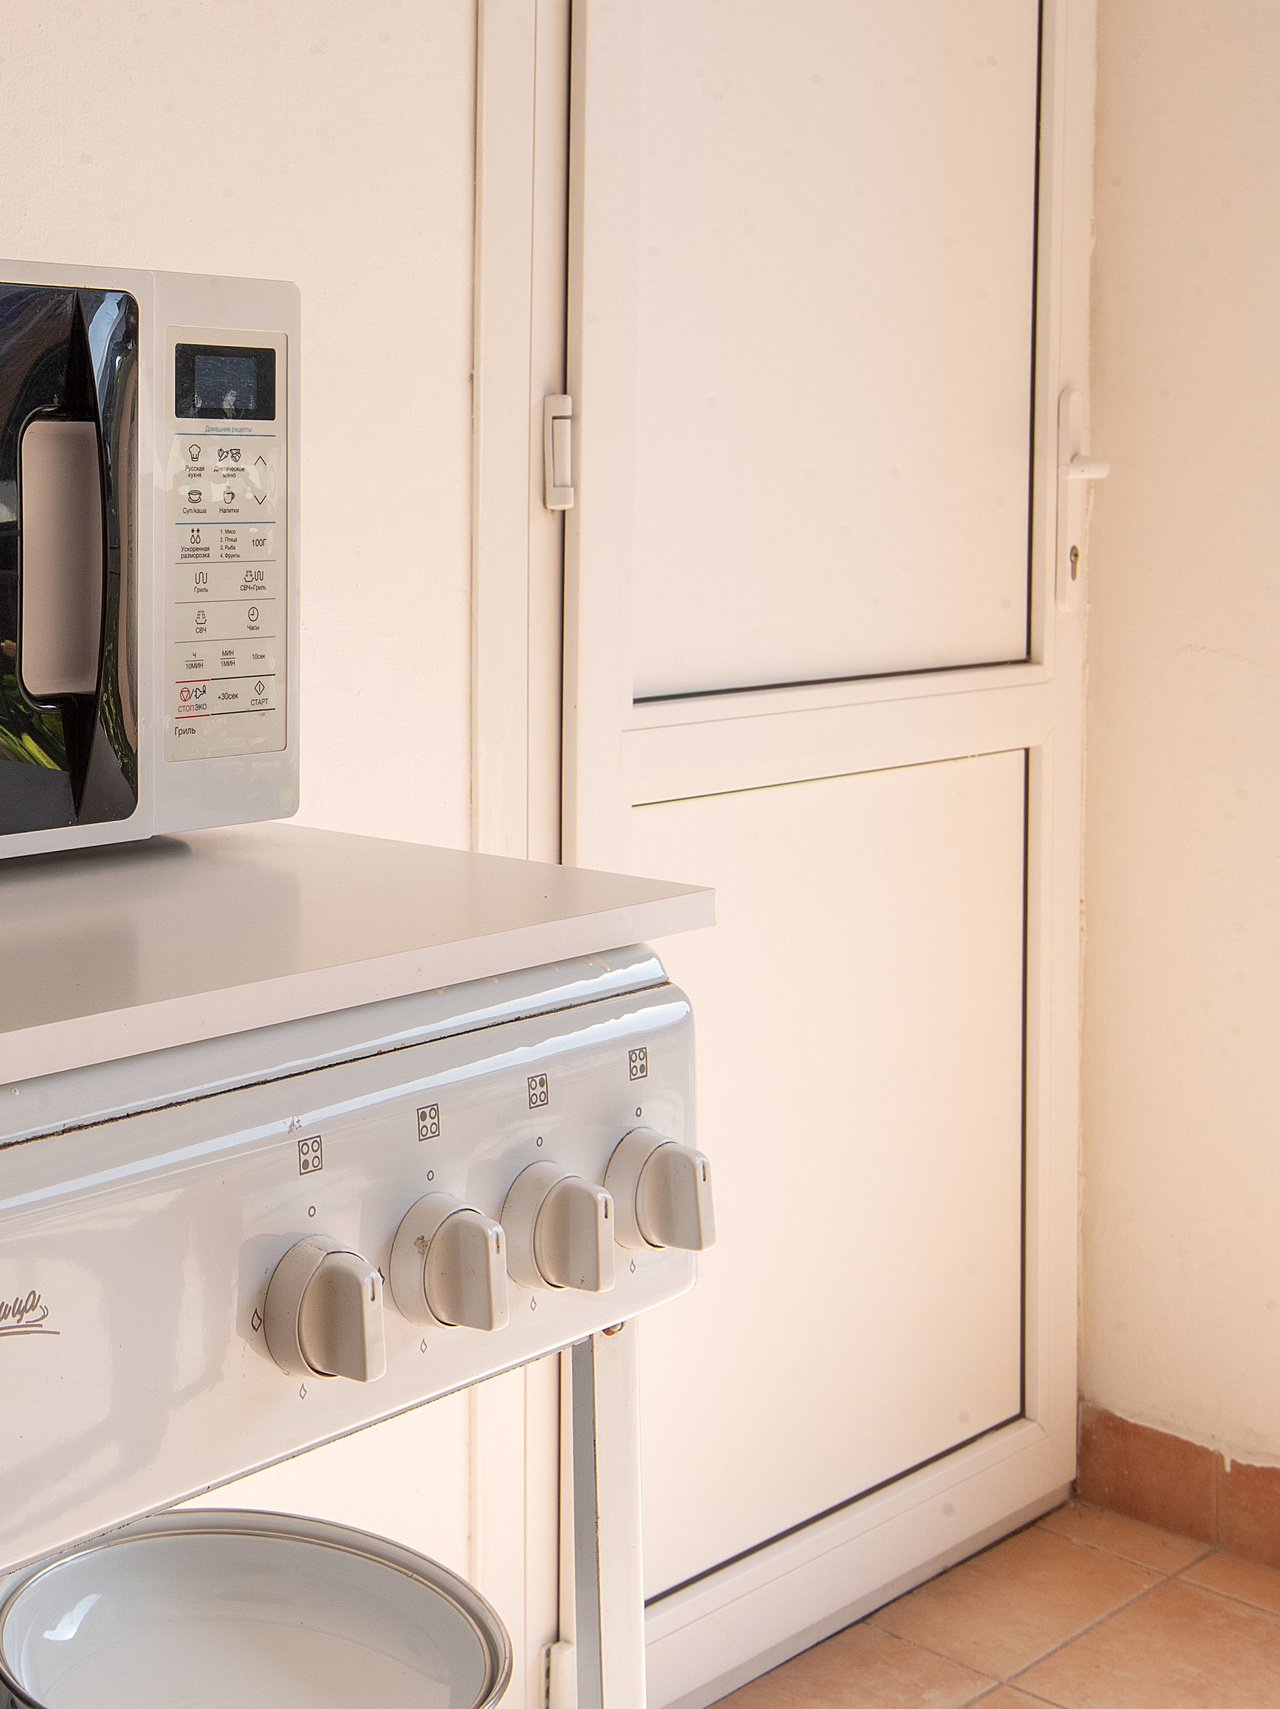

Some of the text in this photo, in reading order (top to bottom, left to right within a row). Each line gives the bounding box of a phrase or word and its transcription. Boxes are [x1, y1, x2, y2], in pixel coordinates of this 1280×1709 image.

[205, 425, 231, 433] Домашние
[182, 507, 207, 515] Суп/каша
[186, 662, 204, 670] 10МИН
[218, 692, 239, 701] +30сек
[251, 698, 269, 706] СТАРТ
[178, 703, 207, 713] СТОП ЭКО
[175, 726, 196, 738] Гриль
